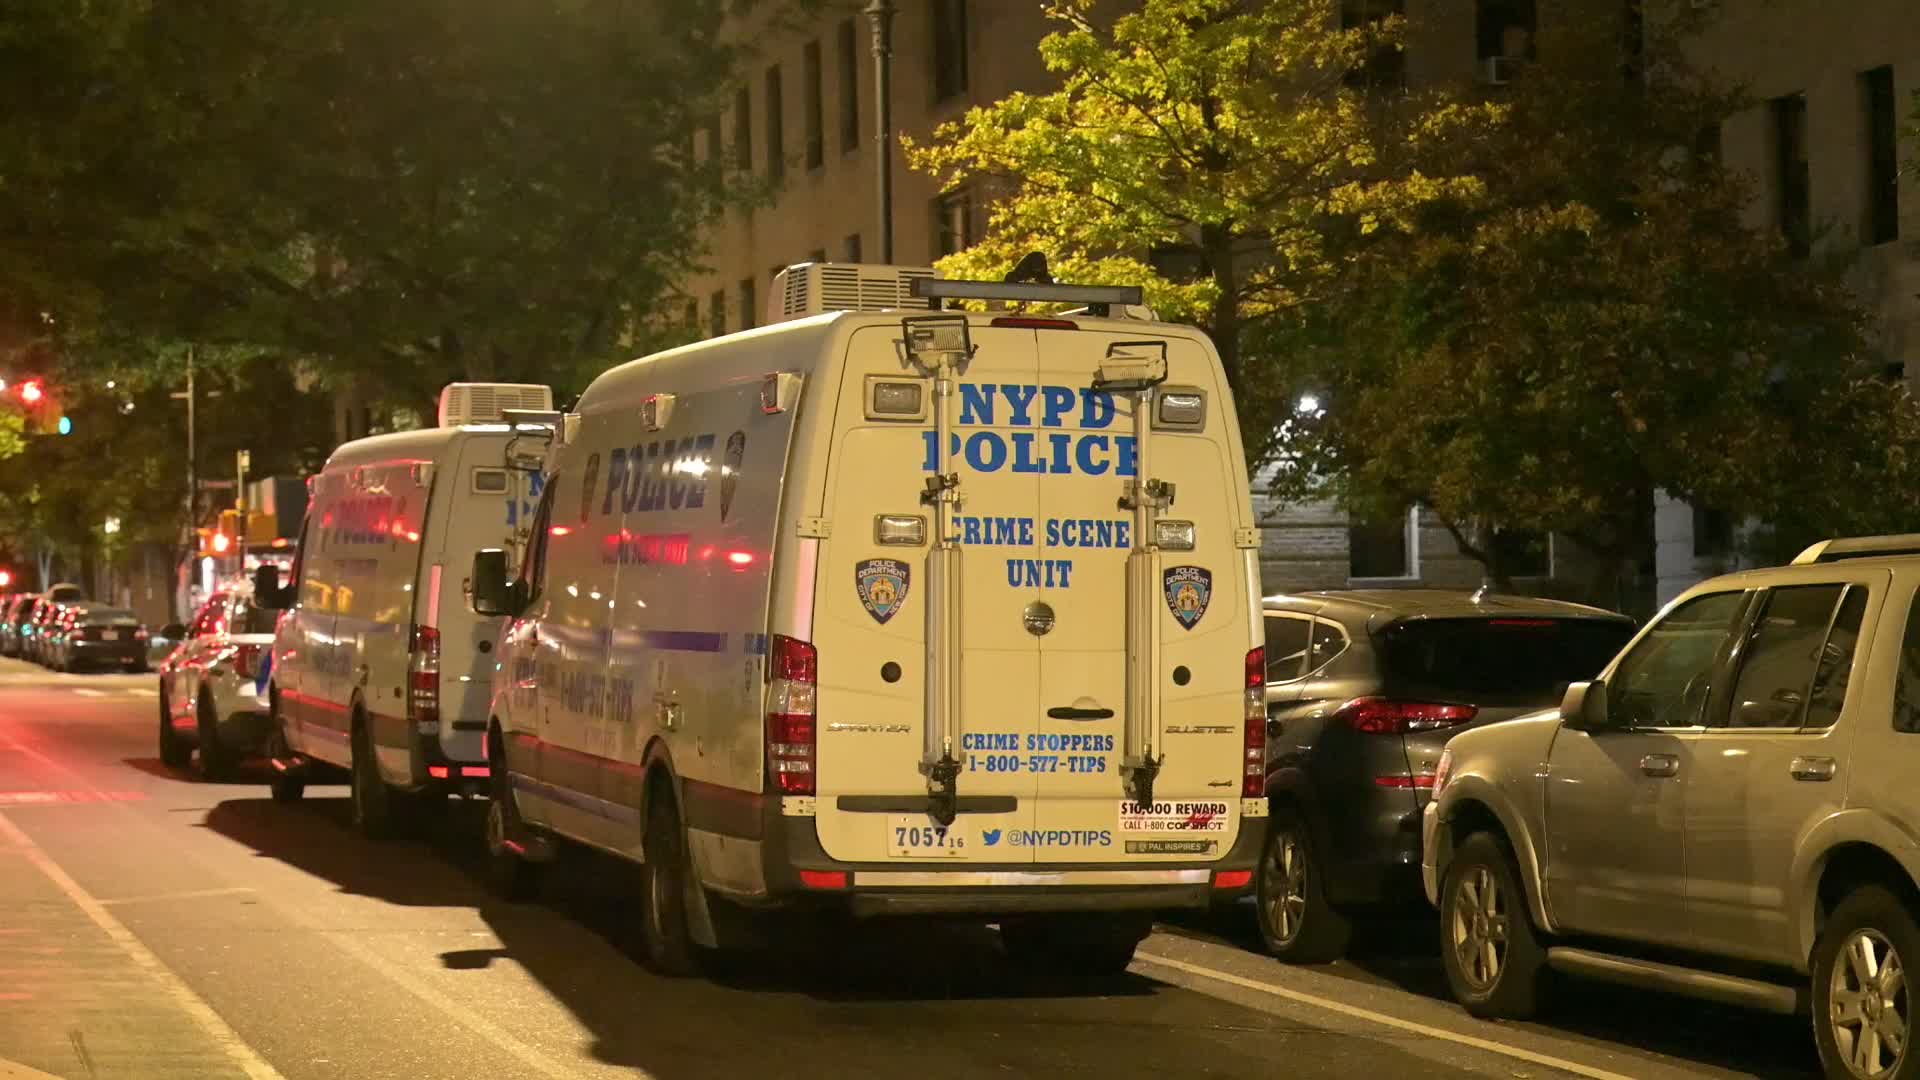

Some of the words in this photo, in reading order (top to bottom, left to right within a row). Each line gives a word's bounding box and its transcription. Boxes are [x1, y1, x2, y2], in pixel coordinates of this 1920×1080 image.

[959, 383, 1115, 428] NYPD
[922, 431, 1138, 476] POLICE
[948, 516, 1034, 545] CRIME
[1046, 518, 1130, 548] SCENE
[858, 567, 907, 579] DEPARTMENT
[869, 560, 897, 568] POLICE
[1007, 559, 1073, 588] UNIT
[962, 733, 1020, 751] CRIME
[1027, 734, 1114, 751] STOPPERS
[970, 755, 1106, 773] 1-800-577-TIPS
[1121, 802, 1171, 816] $10,000
[1175, 803, 1227, 816] REWARD
[1124, 820, 1142, 831] CALL
[1144, 820, 1165, 831] 1-800
[896, 826, 947, 847] 7057
[950, 837, 964, 848] 16
[1007, 830, 1112, 847] @NYPDTIPS
[1149, 843, 1164, 851] PAL
